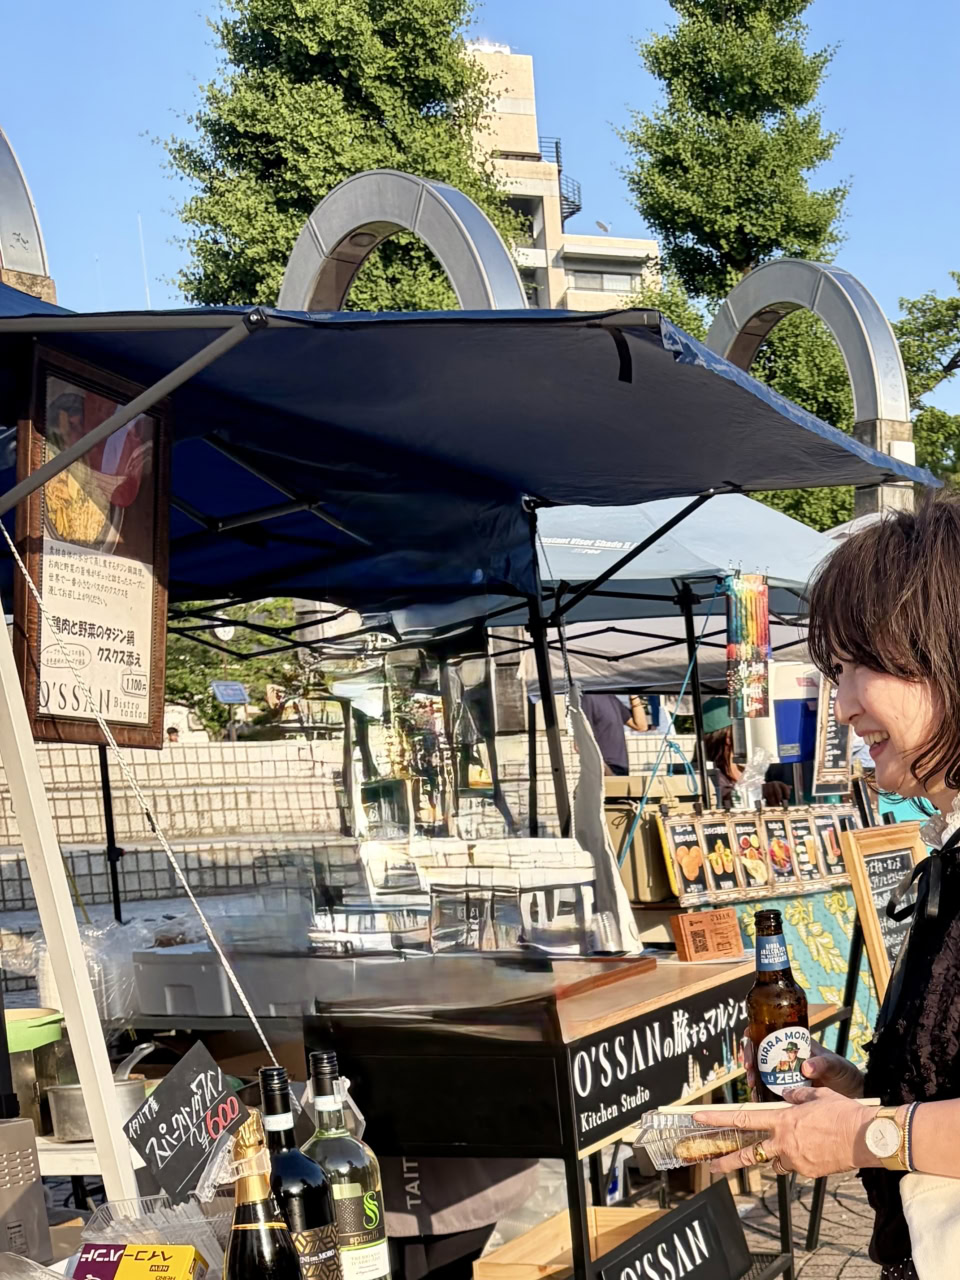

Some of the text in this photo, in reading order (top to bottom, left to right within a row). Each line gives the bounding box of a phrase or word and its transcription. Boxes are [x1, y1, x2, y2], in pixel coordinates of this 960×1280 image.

[97, 646, 142, 668] クスクス添え
[113, 696, 140, 711] Bistro
[760, 1031, 811, 1065] BIRRA MORE
[580, 1085, 650, 1133] Kitchen Studio
[349, 1232, 380, 1247] spinelli
[80, 1249, 173, 1262] ヘイコーバンド
